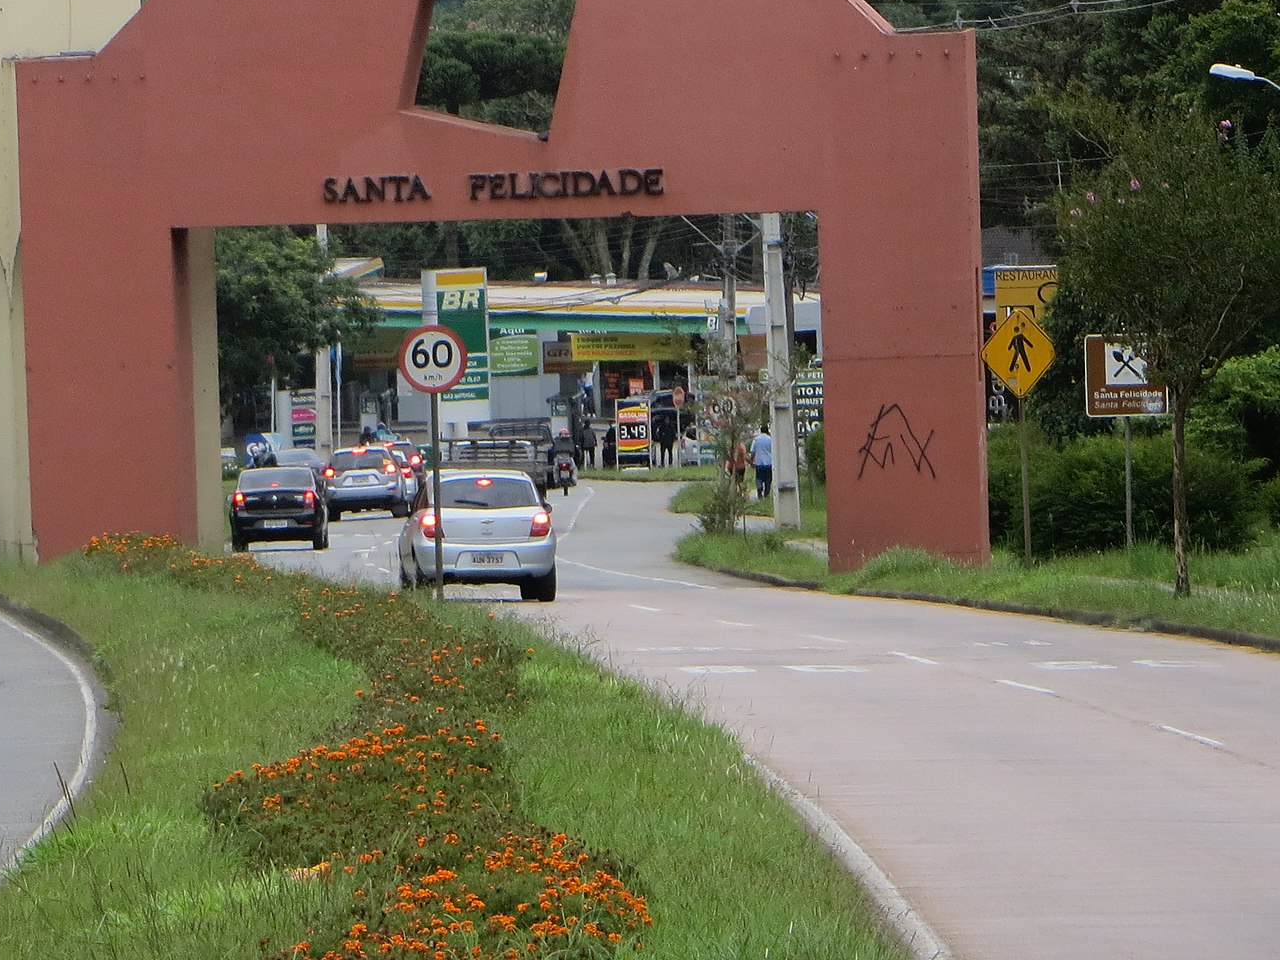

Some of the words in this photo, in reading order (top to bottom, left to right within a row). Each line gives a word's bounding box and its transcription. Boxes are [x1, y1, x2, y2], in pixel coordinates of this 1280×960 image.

[322, 175, 432, 203] SANTA
[468, 168, 665, 201] FELICIDADE
[996, 270, 1057, 281] RESTAURAN
[442, 290, 480, 310] BR
[707, 316, 719, 330] B
[412, 339, 453, 368] 60
[1094, 391, 1119, 399] Santa
[1120, 390, 1163, 398] Felicidade
[1094, 401, 1119, 409] Santa
[620, 425, 647, 439] 3.49
